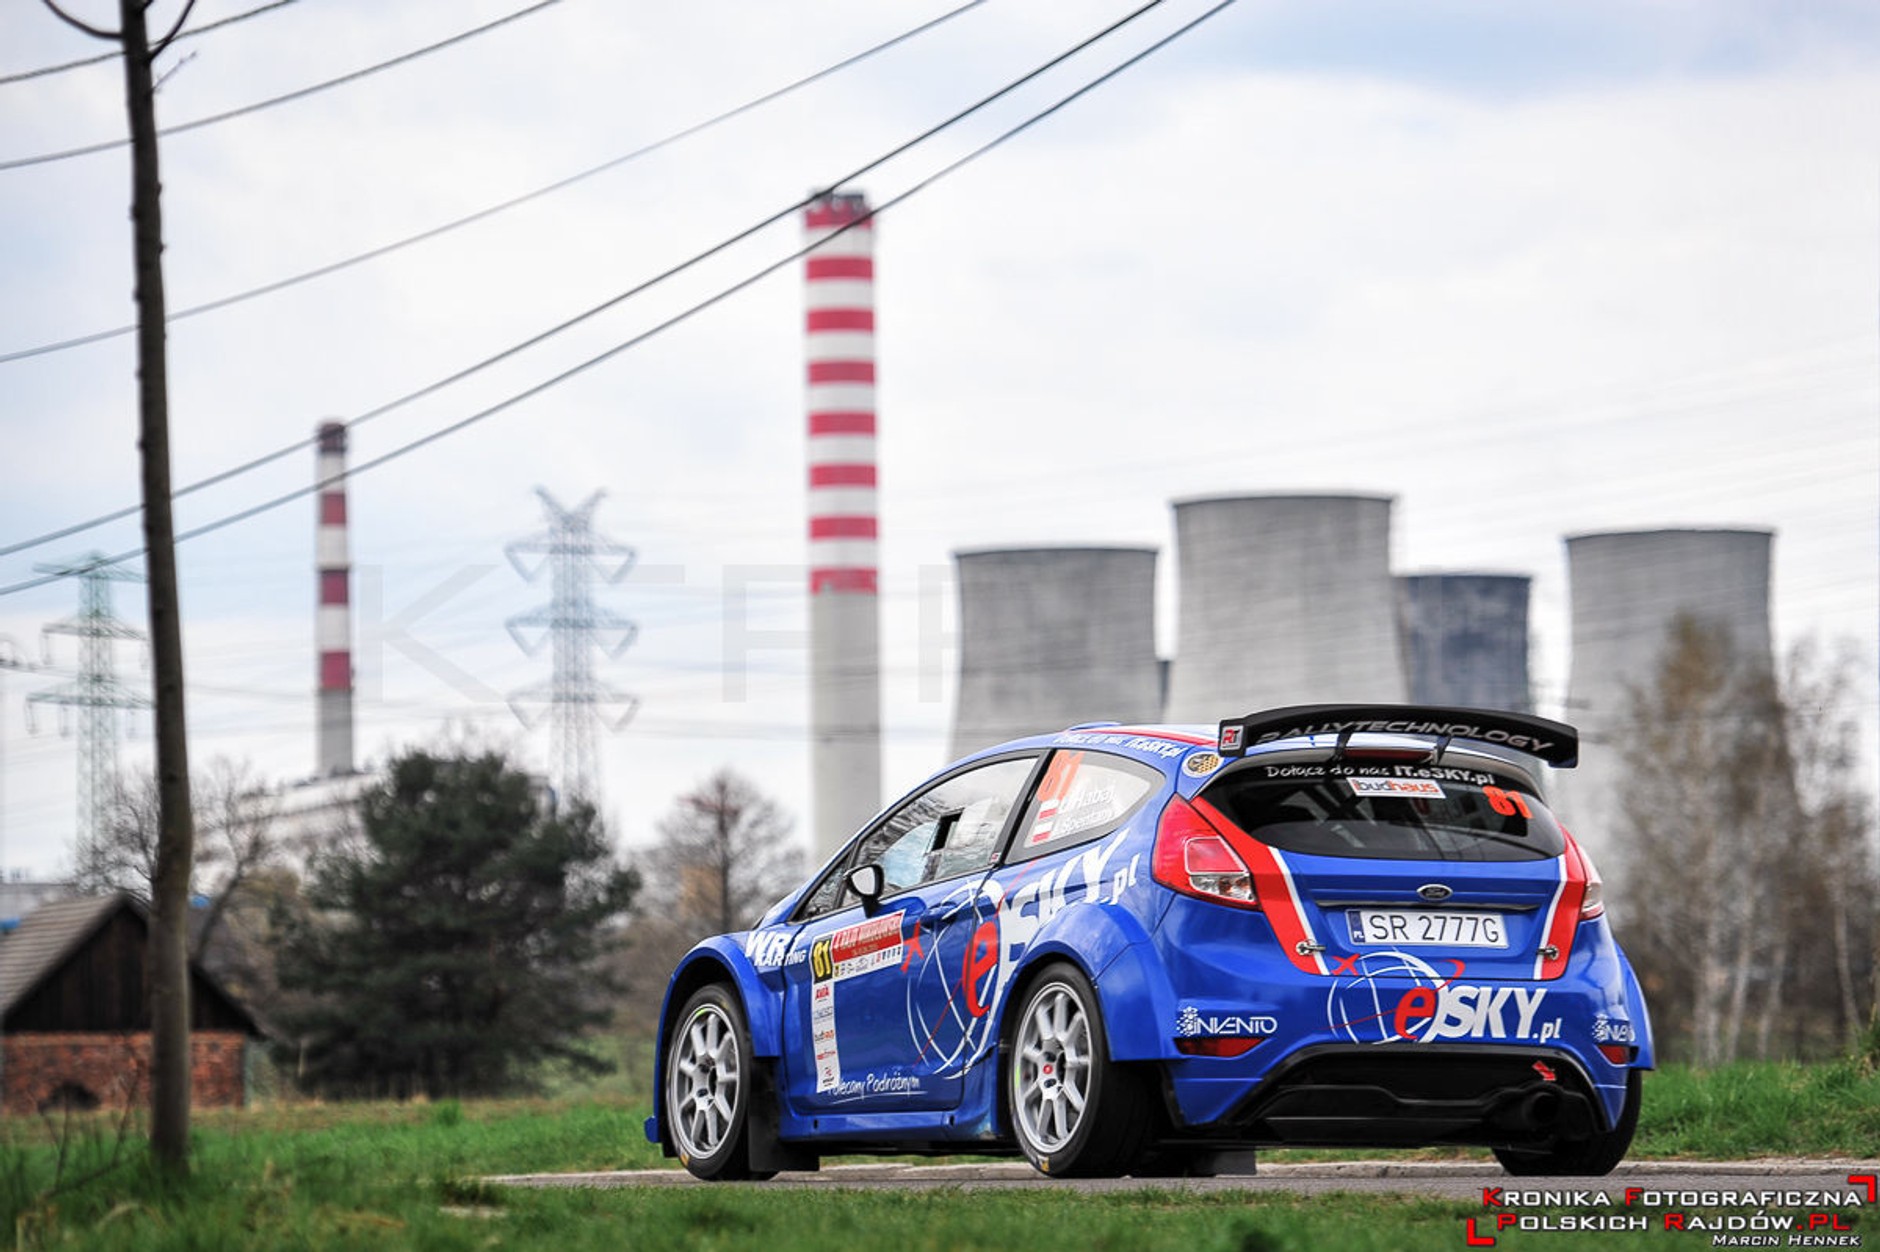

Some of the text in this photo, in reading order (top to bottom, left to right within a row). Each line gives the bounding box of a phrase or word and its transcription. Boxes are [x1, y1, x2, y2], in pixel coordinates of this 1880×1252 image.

[1037, 750, 1086, 801] 81
[1482, 785, 1534, 819] 81
[1369, 914, 1500, 943] SR 2777G
[813, 939, 832, 978] 81
